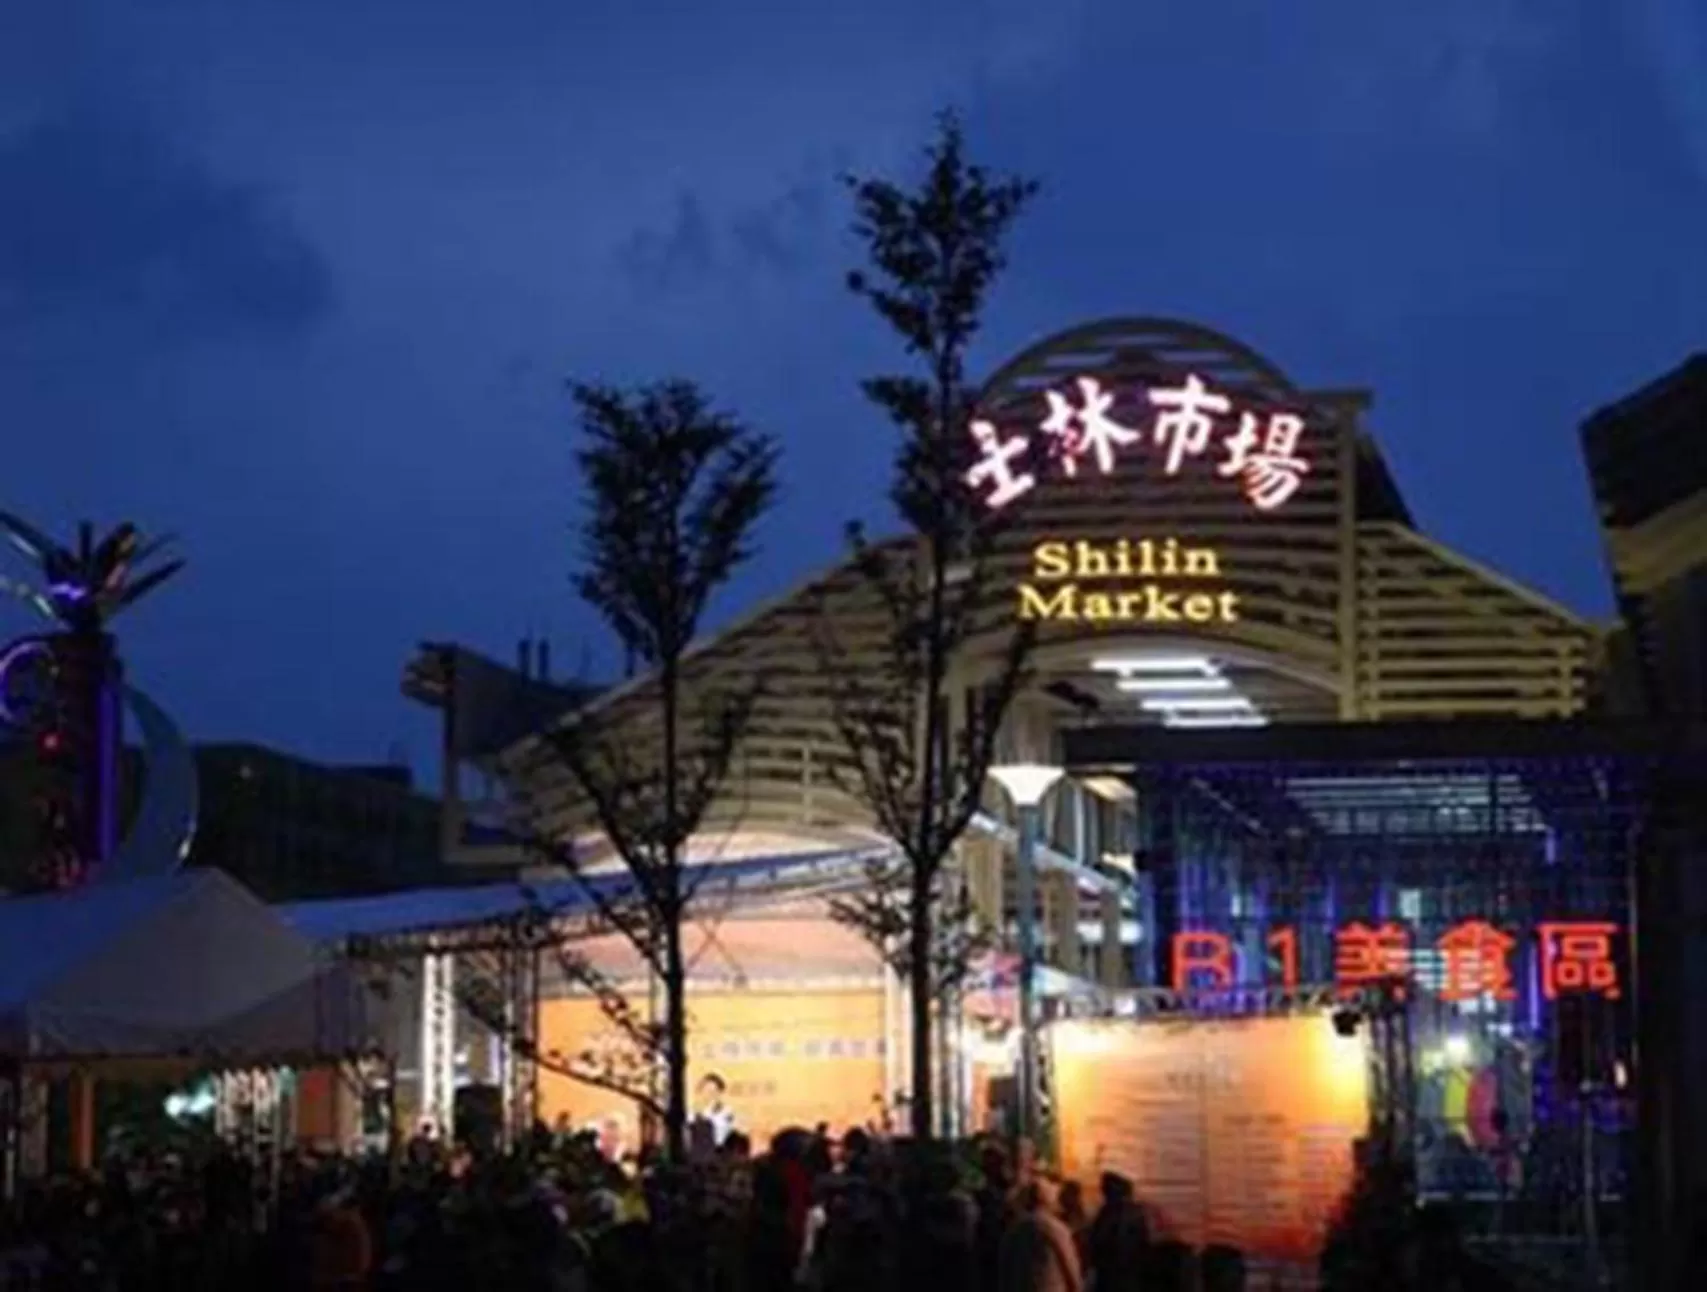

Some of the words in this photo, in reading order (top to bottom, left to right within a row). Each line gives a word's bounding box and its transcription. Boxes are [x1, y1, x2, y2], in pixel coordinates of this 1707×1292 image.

[965, 374, 1311, 509] 士林市場
[1034, 539, 1220, 577] Shilin
[1017, 584, 1241, 621] Market
